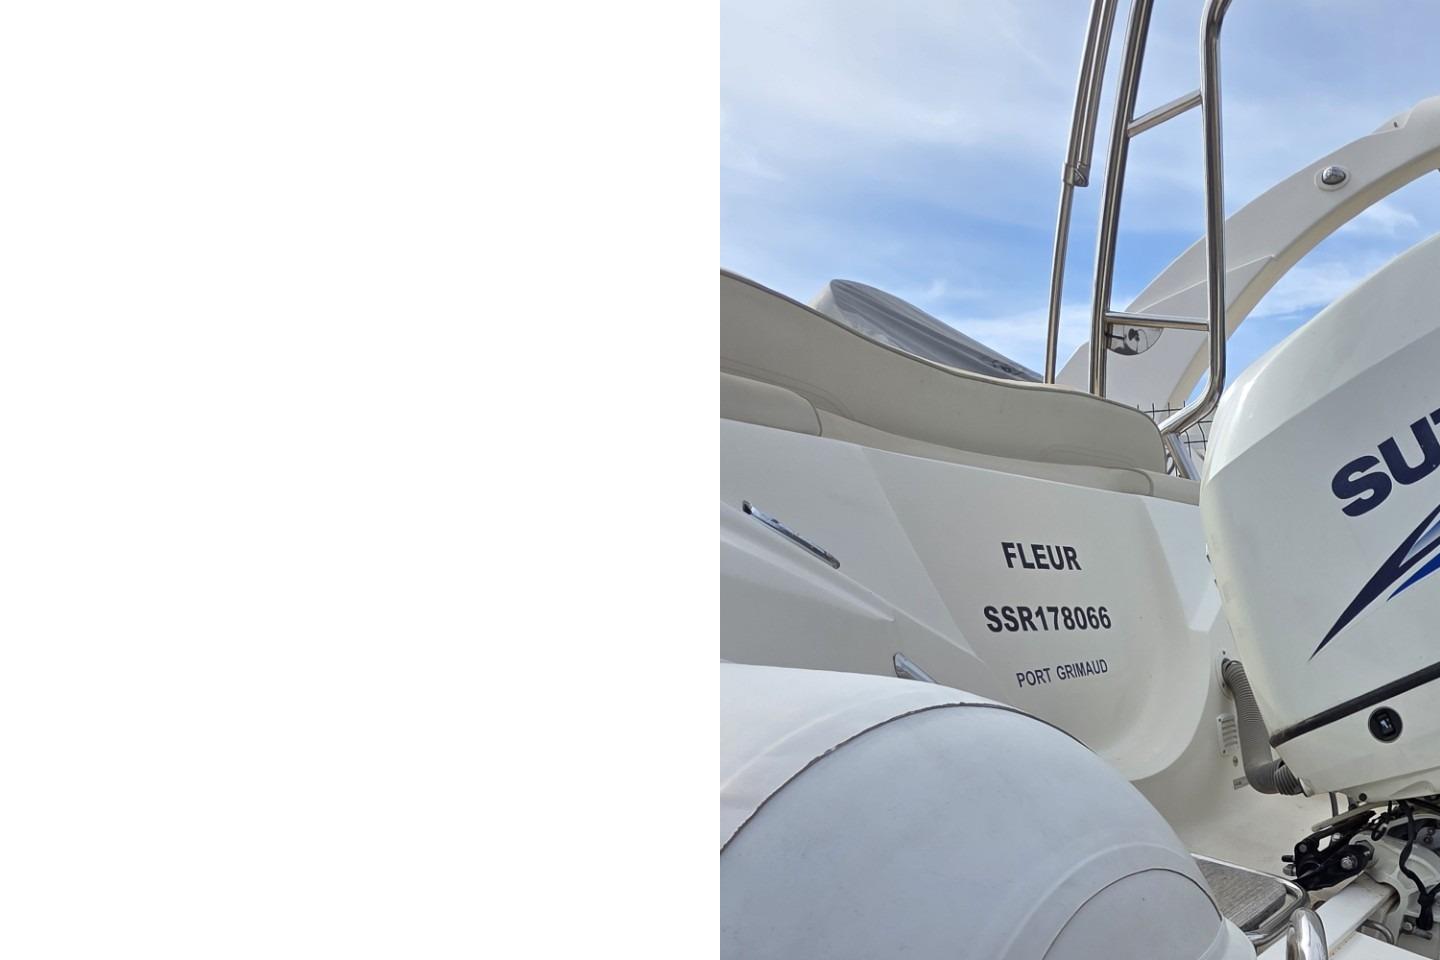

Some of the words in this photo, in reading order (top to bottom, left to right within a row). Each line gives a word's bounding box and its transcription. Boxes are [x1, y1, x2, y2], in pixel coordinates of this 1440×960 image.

[1001, 541, 1082, 571] FLEUR
[983, 605, 1112, 633] SSR178066
[1016, 667, 1051, 688] PORT
[1056, 658, 1108, 680] GRIMAUD
